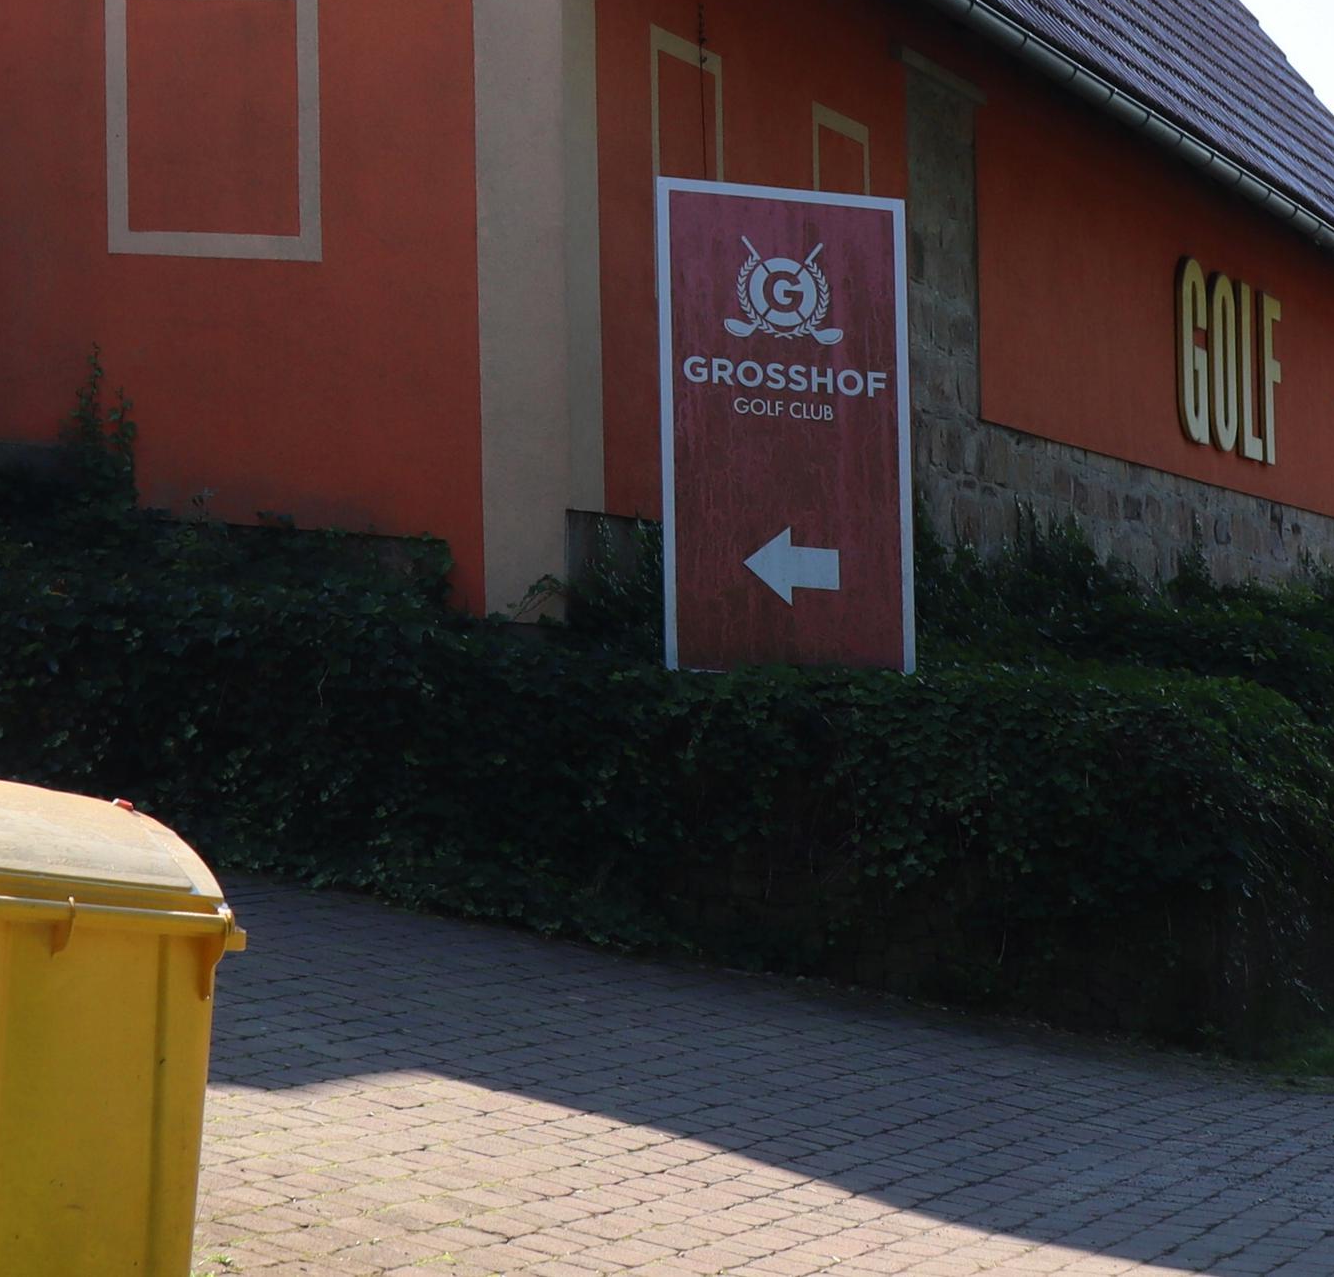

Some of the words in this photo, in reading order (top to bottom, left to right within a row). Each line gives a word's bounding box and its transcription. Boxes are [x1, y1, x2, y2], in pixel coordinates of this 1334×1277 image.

[762, 269, 805, 313] G
[682, 355, 888, 399] GROSSHOF
[1177, 257, 1282, 466] GOLF
[733, 396, 785, 417] GOLF
[788, 401, 835, 422] CLUB
